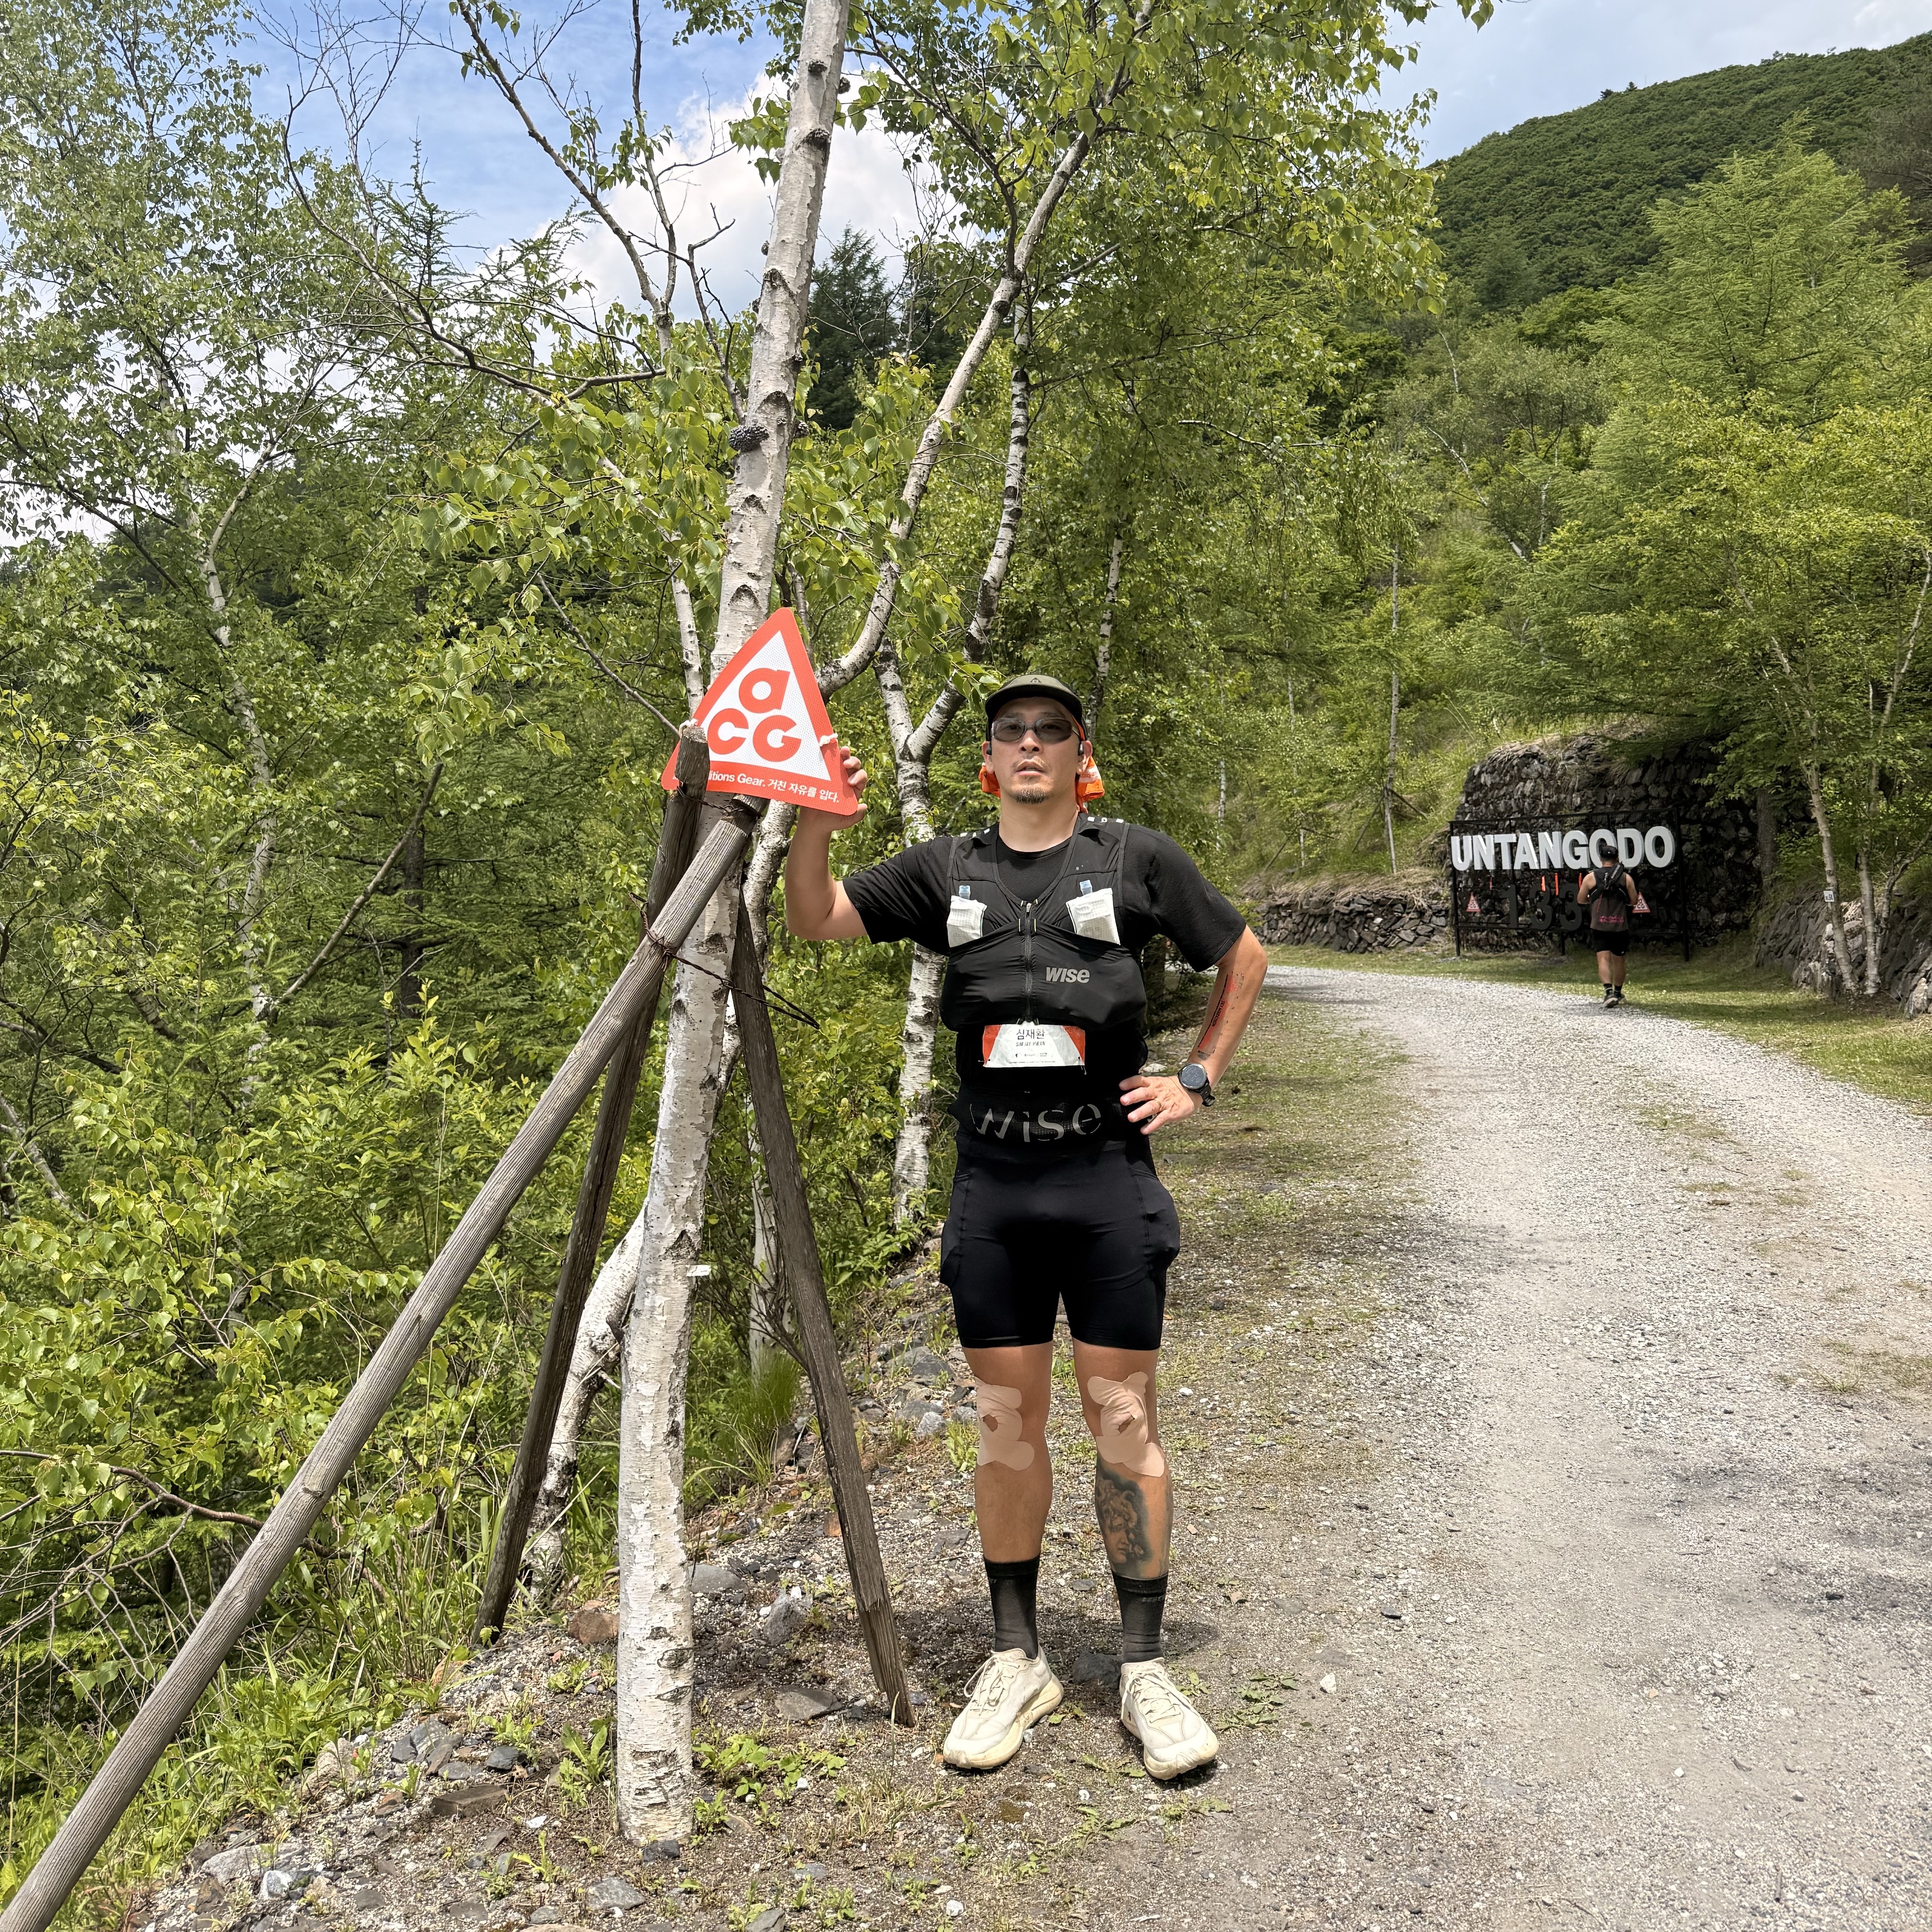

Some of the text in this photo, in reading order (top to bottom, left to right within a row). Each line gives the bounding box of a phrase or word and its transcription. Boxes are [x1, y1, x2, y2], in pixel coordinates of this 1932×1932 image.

[708, 771, 766, 787] itions Gear.
[768, 779, 840, 803] 거친 자유를 입다.
[1450, 826, 1675, 871] UNTANGODO
[1016, 1028, 1045, 1040] 심재환
